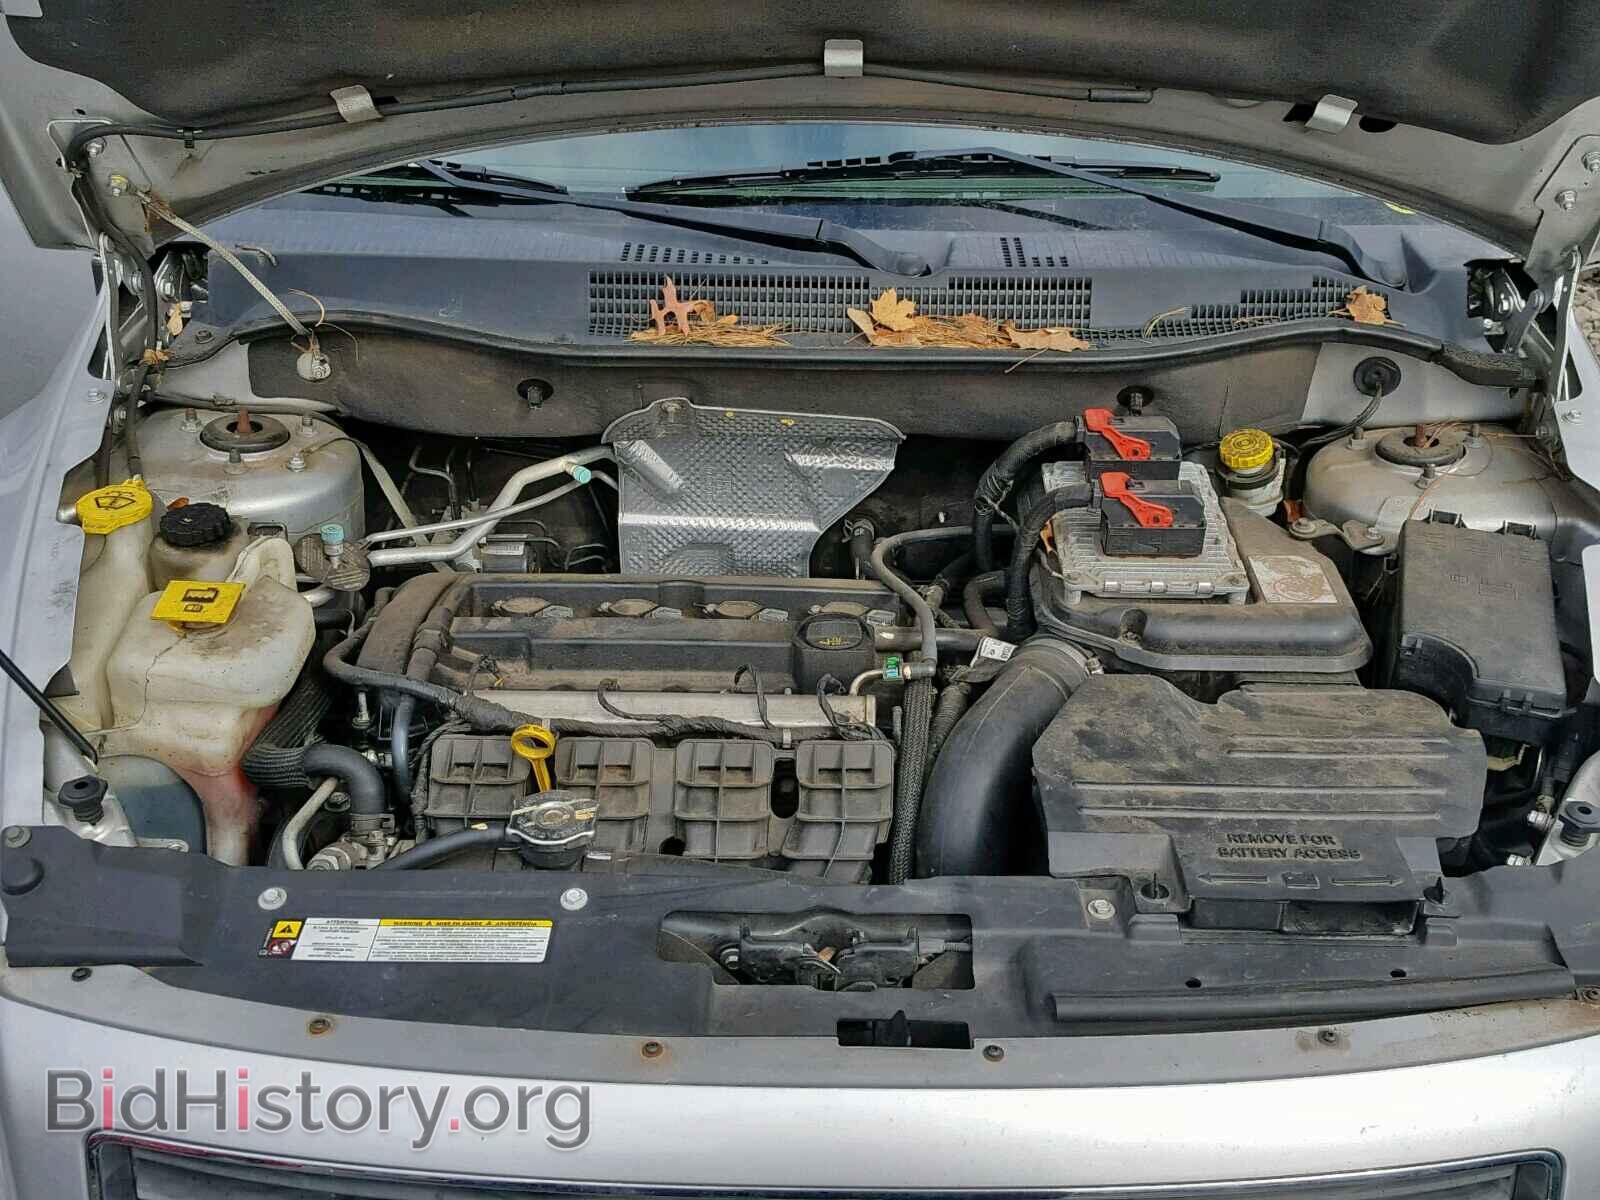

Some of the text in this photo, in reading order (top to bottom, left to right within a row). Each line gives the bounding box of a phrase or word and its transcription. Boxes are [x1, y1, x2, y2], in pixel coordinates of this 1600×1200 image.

[1226, 833, 1337, 846] REMOVE FOR
[1217, 847, 1361, 860] BATTERY ACCESS
